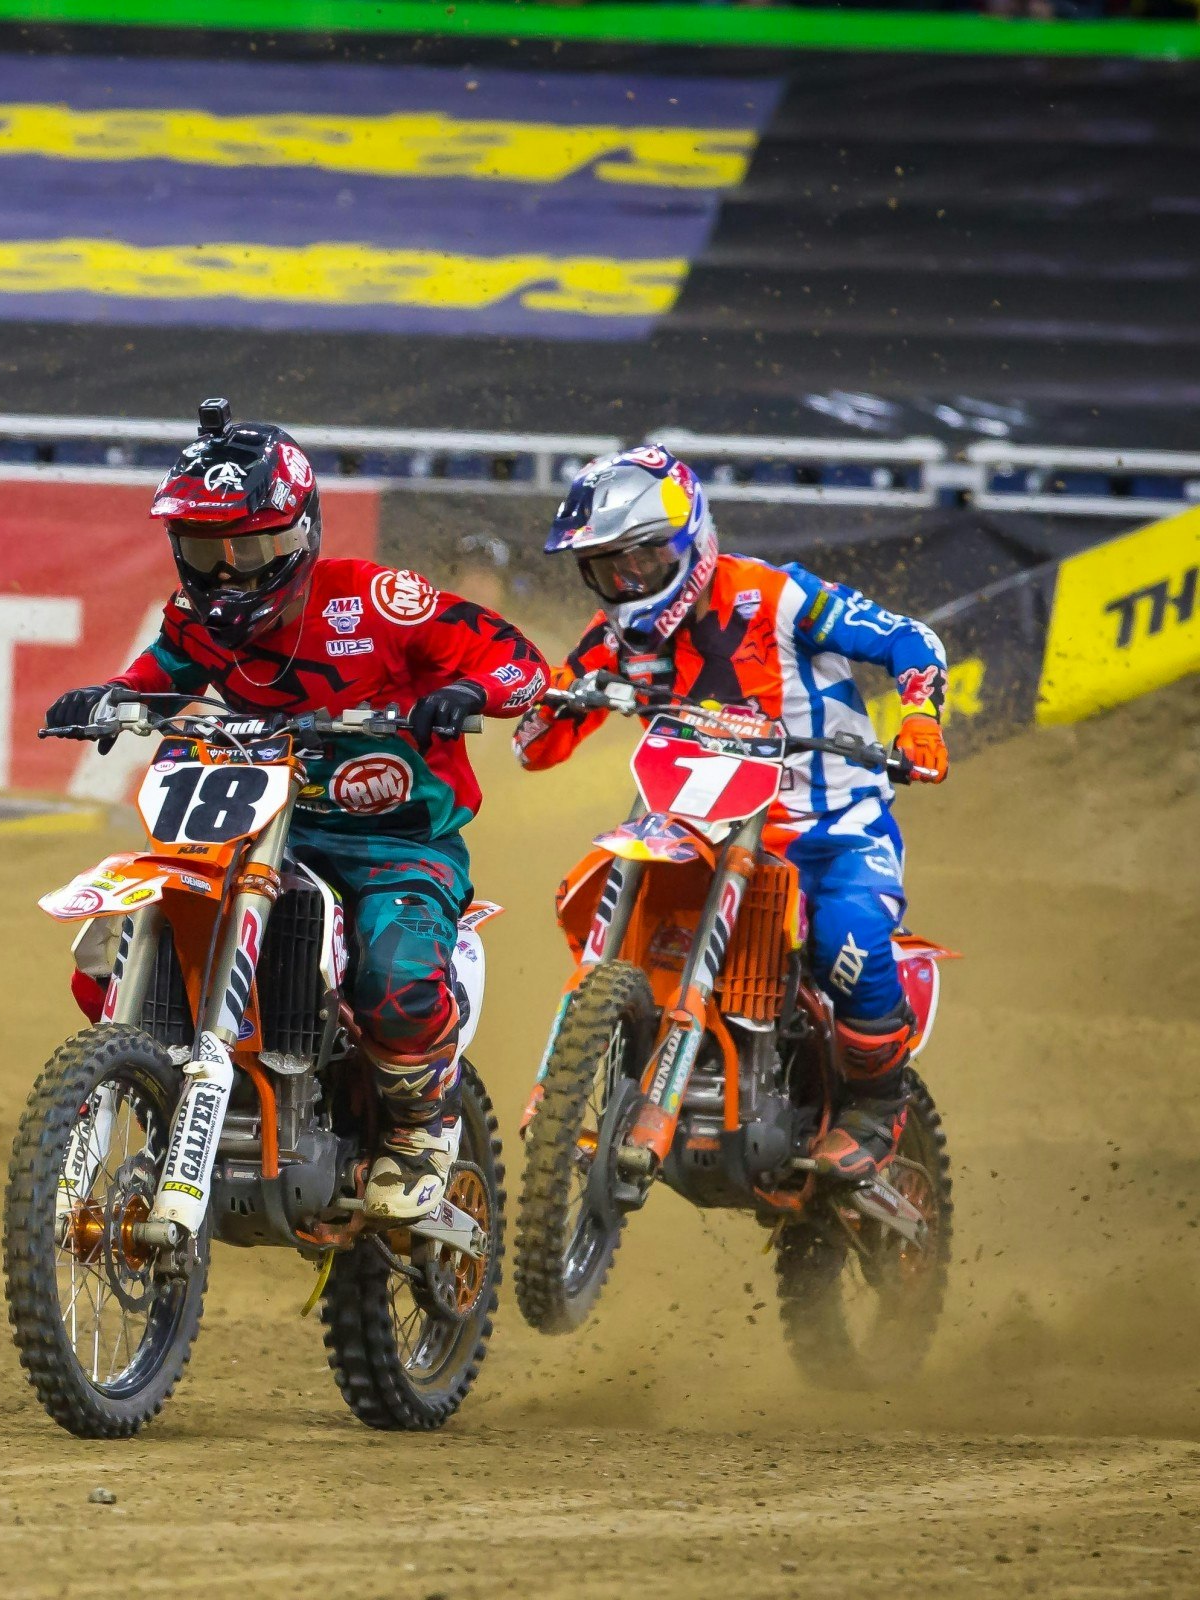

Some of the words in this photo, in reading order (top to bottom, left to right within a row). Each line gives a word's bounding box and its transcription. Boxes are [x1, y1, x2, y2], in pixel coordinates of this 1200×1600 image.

[325, 598, 360, 614] AMA
[327, 639, 373, 655] WPS
[206, 747, 254, 758] ONSTR
[673, 754, 744, 818] 1
[153, 766, 269, 843] 18
[177, 844, 210, 855] KTM
[829, 931, 869, 997] FOX
[180, 1092, 216, 1181] GALFER
[164, 1182, 203, 1199] EXCEL
